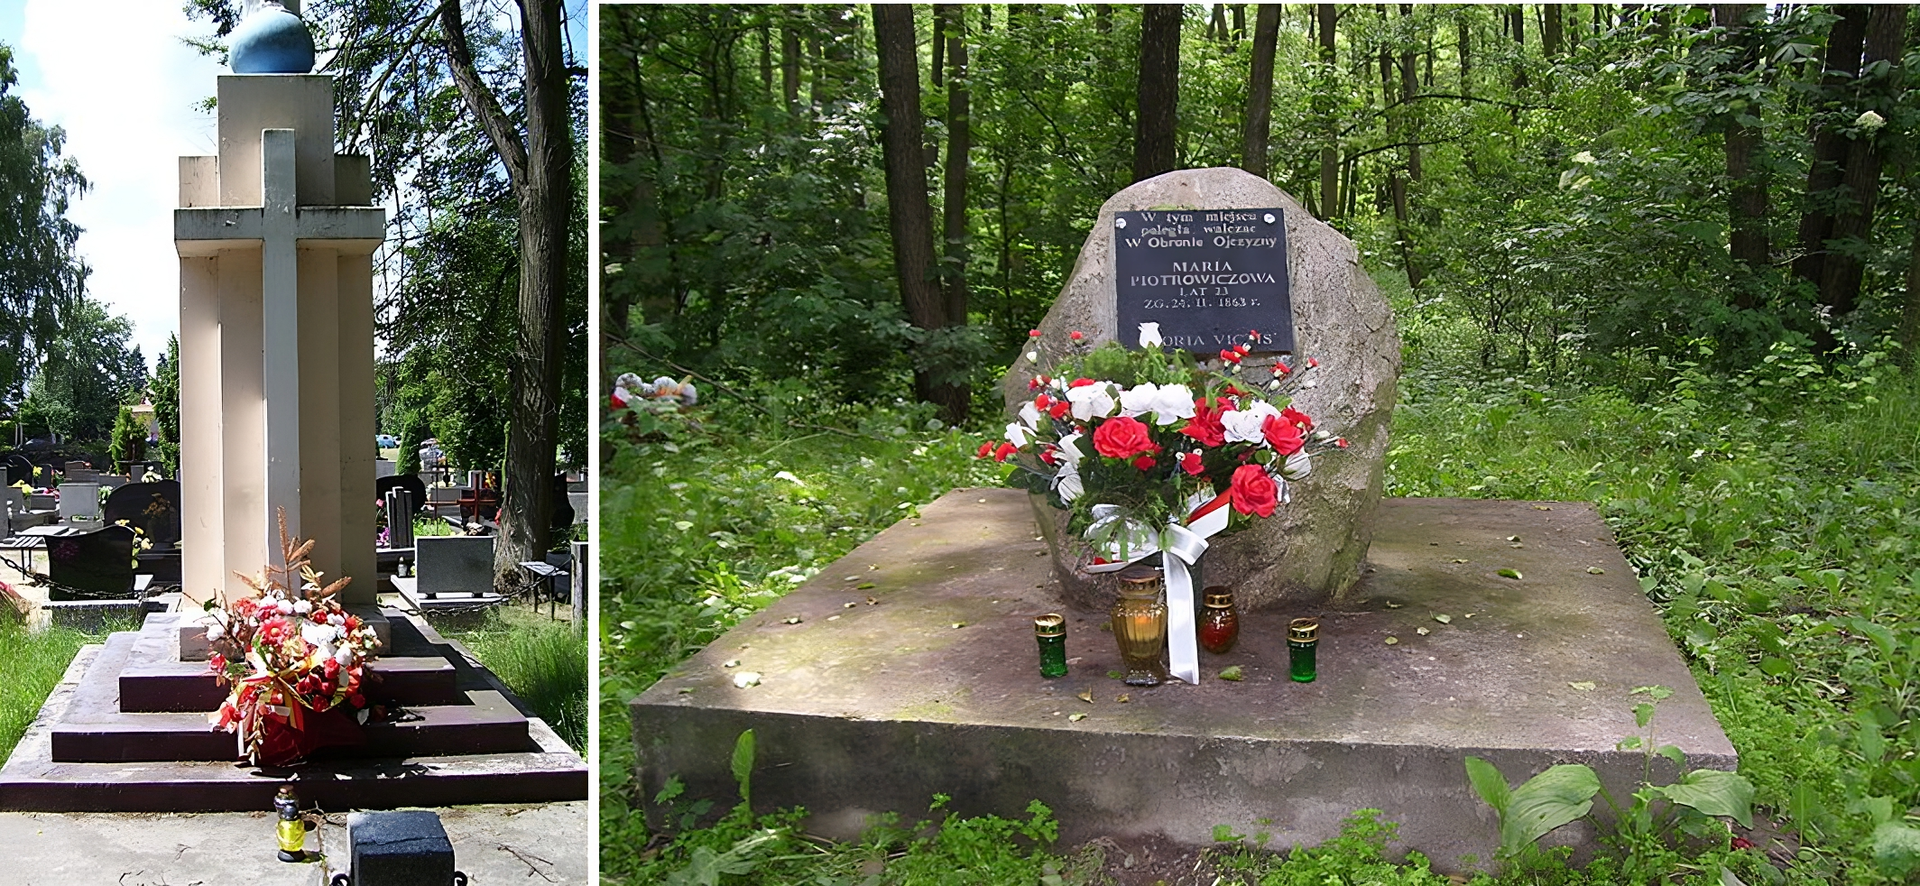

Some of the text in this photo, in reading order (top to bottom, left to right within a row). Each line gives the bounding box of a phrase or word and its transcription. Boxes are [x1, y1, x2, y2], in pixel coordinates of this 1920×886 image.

[1141, 213, 1157, 222] W
[1166, 213, 1193, 225] tym
[1125, 238, 1141, 248] W
[1213, 235, 1277, 248] Ojczyzny
[1173, 261, 1233, 272] MARIA
[1130, 273, 1276, 287] PIOTROWICZOWA
[1180, 287, 1208, 296] LAT
[1219, 298, 1247, 307] 1863
[1162, 335, 1205, 347] ORIA
